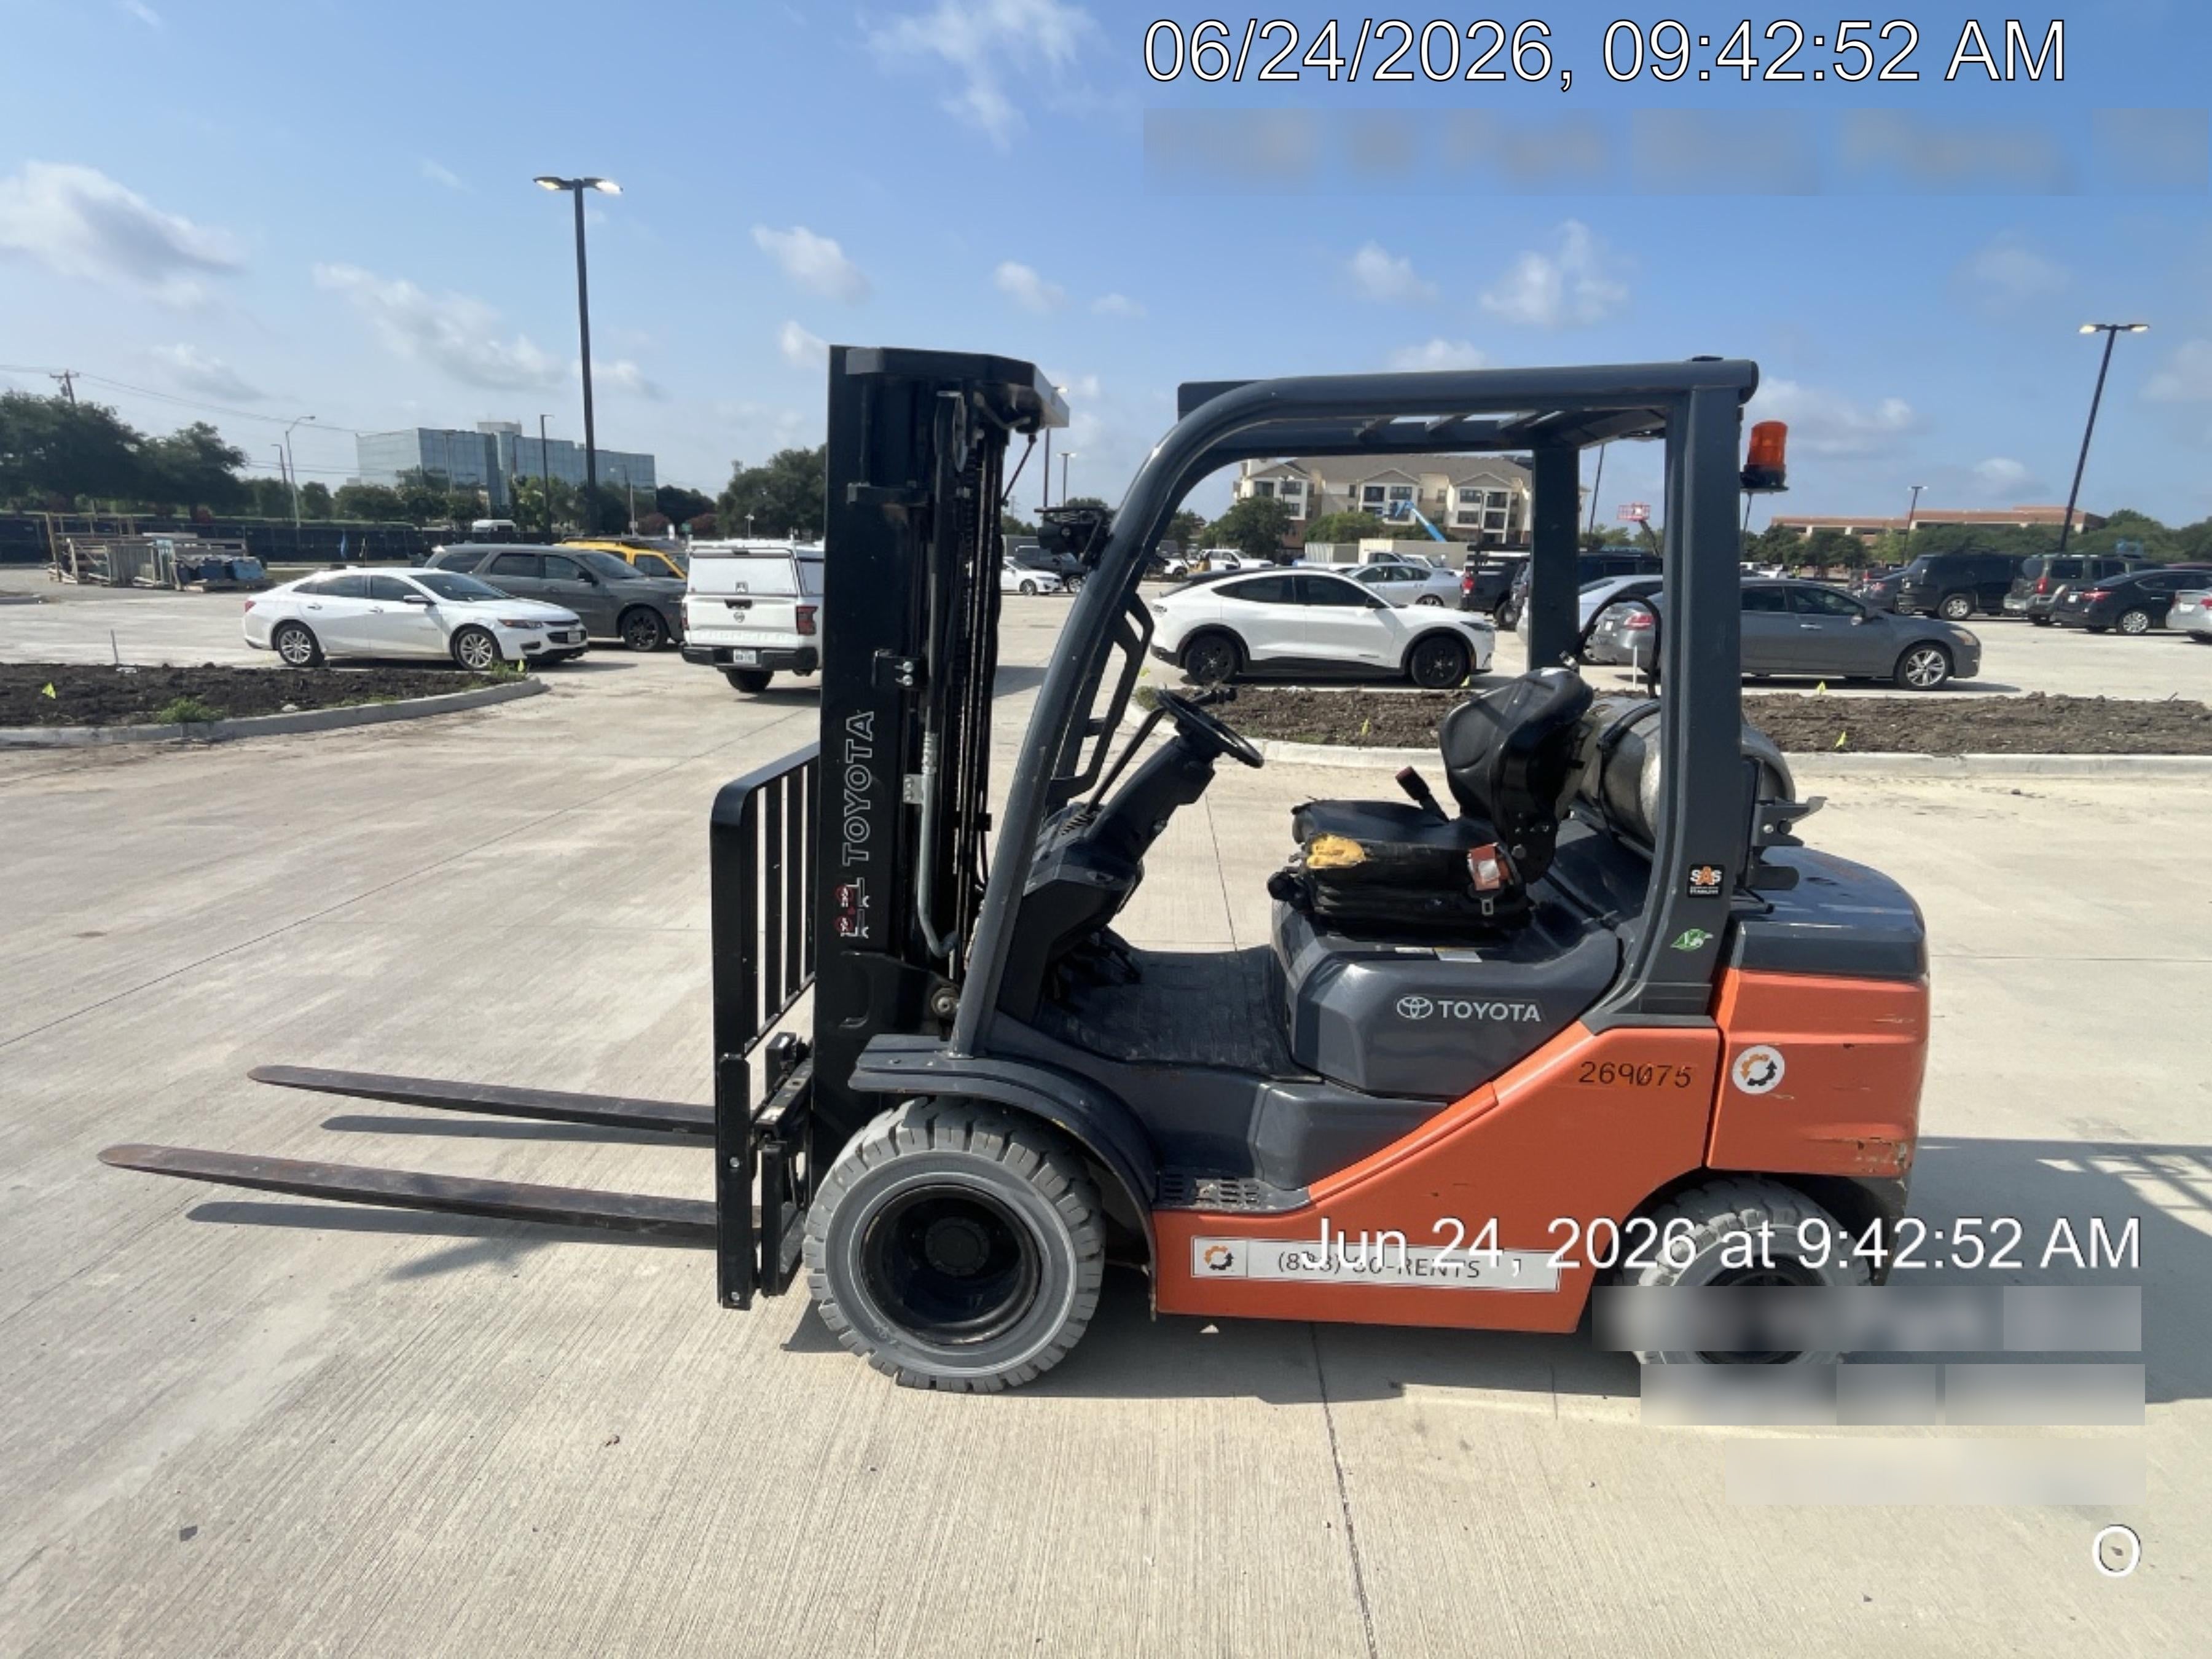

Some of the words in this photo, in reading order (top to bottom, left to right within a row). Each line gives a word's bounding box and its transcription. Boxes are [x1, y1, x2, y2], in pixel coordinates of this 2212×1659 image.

[842, 710, 875, 867] TOYOTA
[1690, 866, 1722, 885] SAS
[1437, 1000, 1542, 1022] TOYOTA
[1579, 1061, 1693, 1088] 269075
